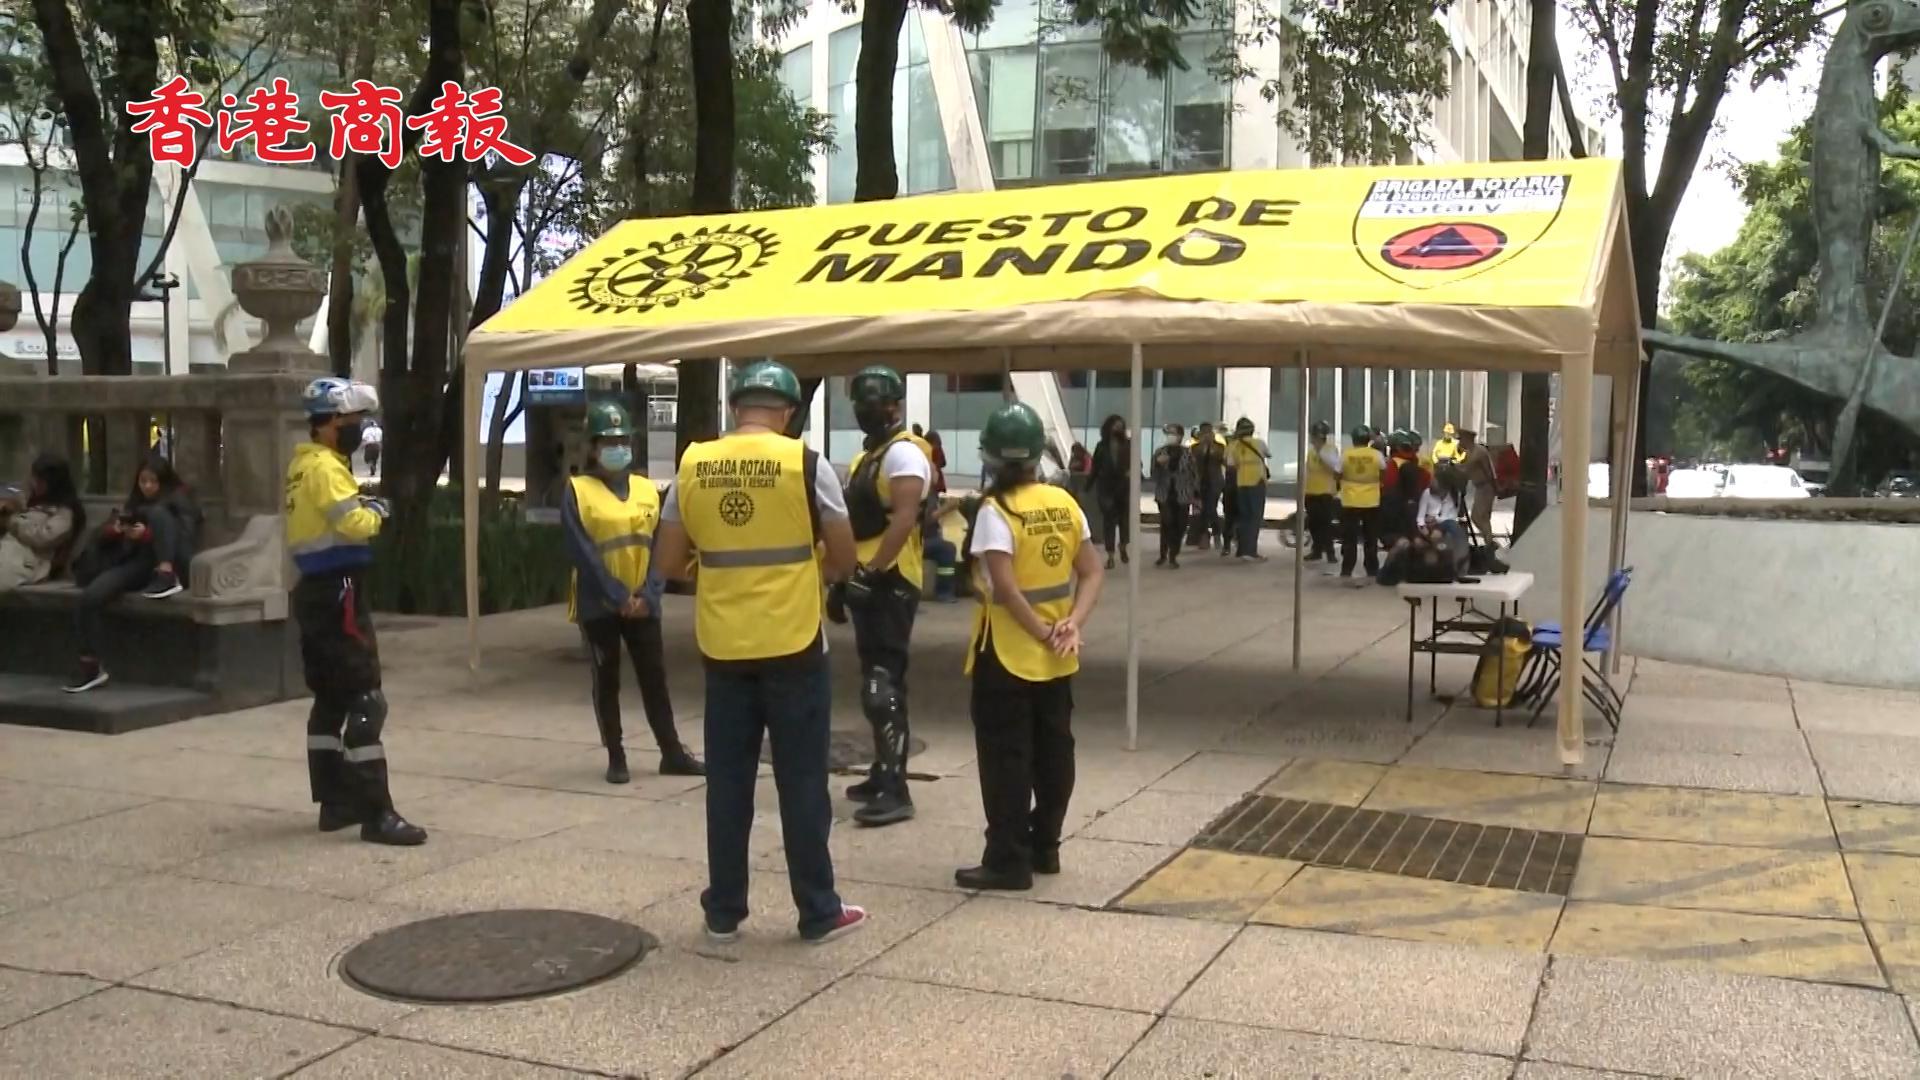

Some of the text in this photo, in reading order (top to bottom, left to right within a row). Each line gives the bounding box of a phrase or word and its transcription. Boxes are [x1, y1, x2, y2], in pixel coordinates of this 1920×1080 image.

[1374, 175, 1565, 194] BRIGADA ROTARIA
[815, 195, 1301, 252] PUESTO DE
[796, 228, 1247, 284] MANDO
[696, 459, 782, 478] BRIGADA ROTARIA
